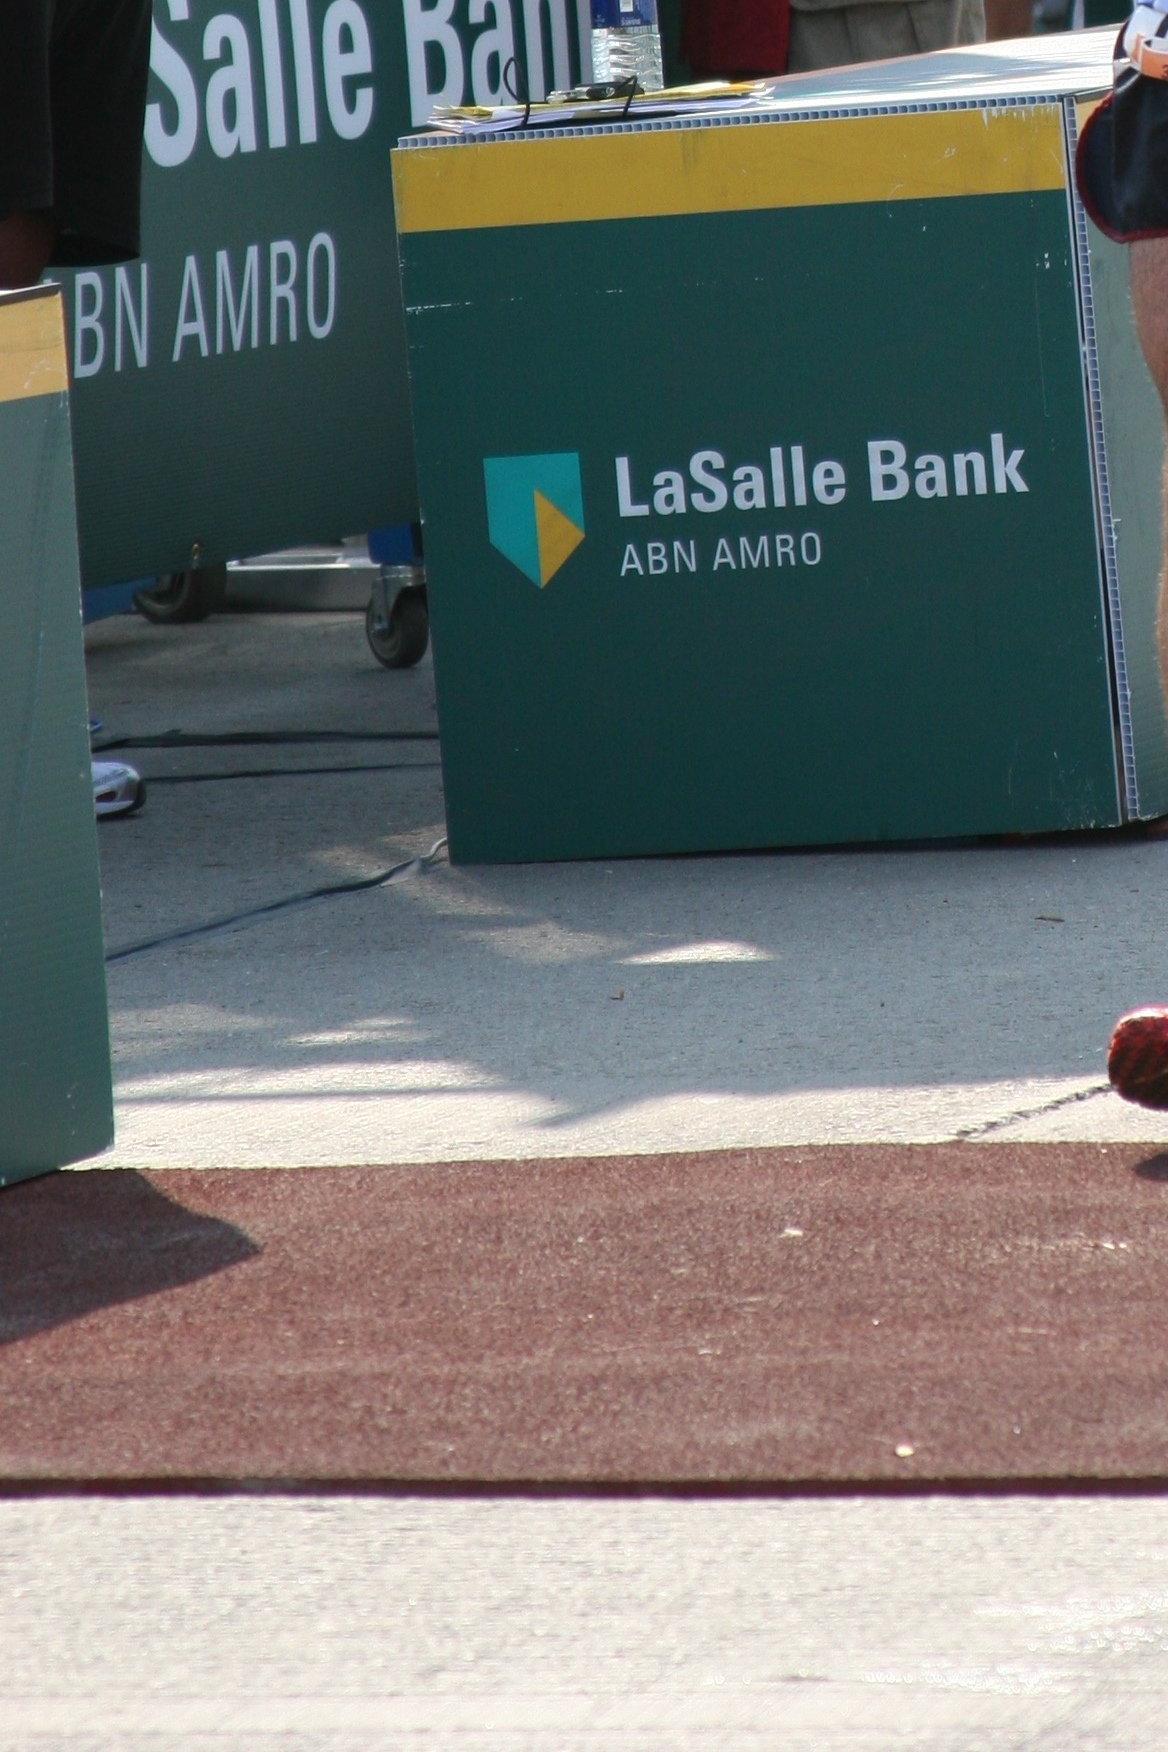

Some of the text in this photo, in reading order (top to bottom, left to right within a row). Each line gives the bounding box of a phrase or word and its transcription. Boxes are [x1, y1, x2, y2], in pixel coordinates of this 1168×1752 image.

[171, 231, 337, 362] AMRO
[614, 432, 1031, 518] LaSalle Bank
[619, 532, 823, 577] ABN AMRO
